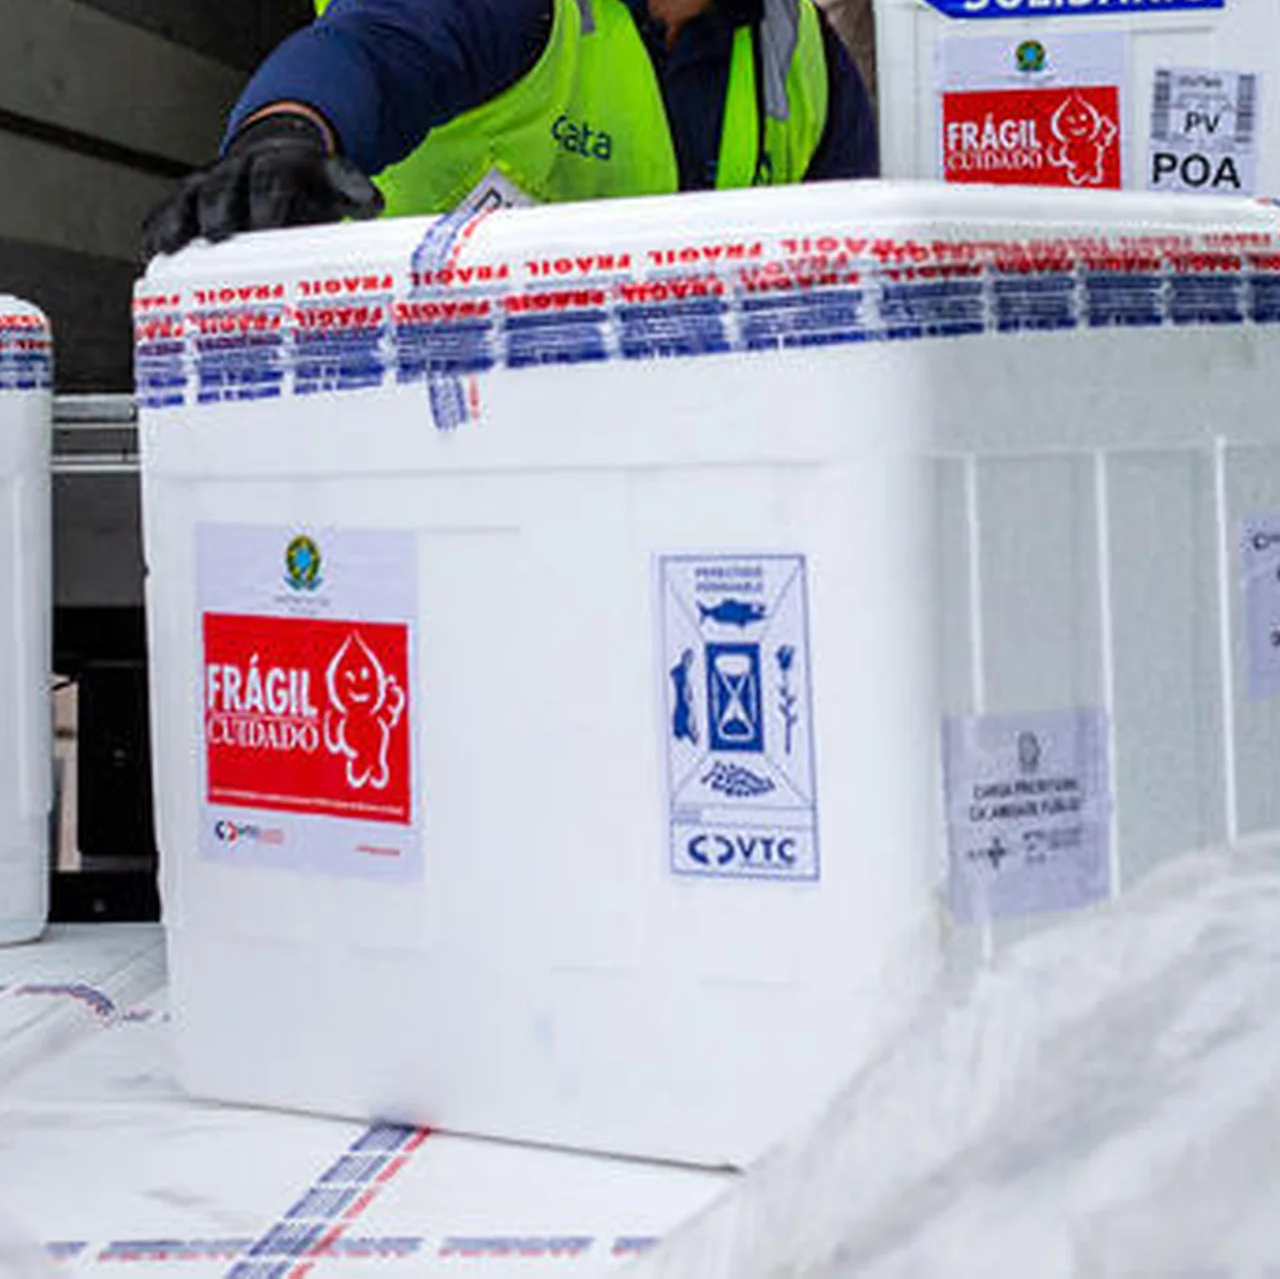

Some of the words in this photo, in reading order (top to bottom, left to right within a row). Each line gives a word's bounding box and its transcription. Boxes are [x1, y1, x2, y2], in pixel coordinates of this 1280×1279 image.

[947, 111, 1043, 151] FRÁGIL
[1184, 110, 1221, 134] PV
[947, 150, 1043, 172] CUIDADO
[1152, 152, 1242, 189] POA
[207, 652, 319, 716] FRÁGIL
[207, 718, 320, 753] CUIDADO
